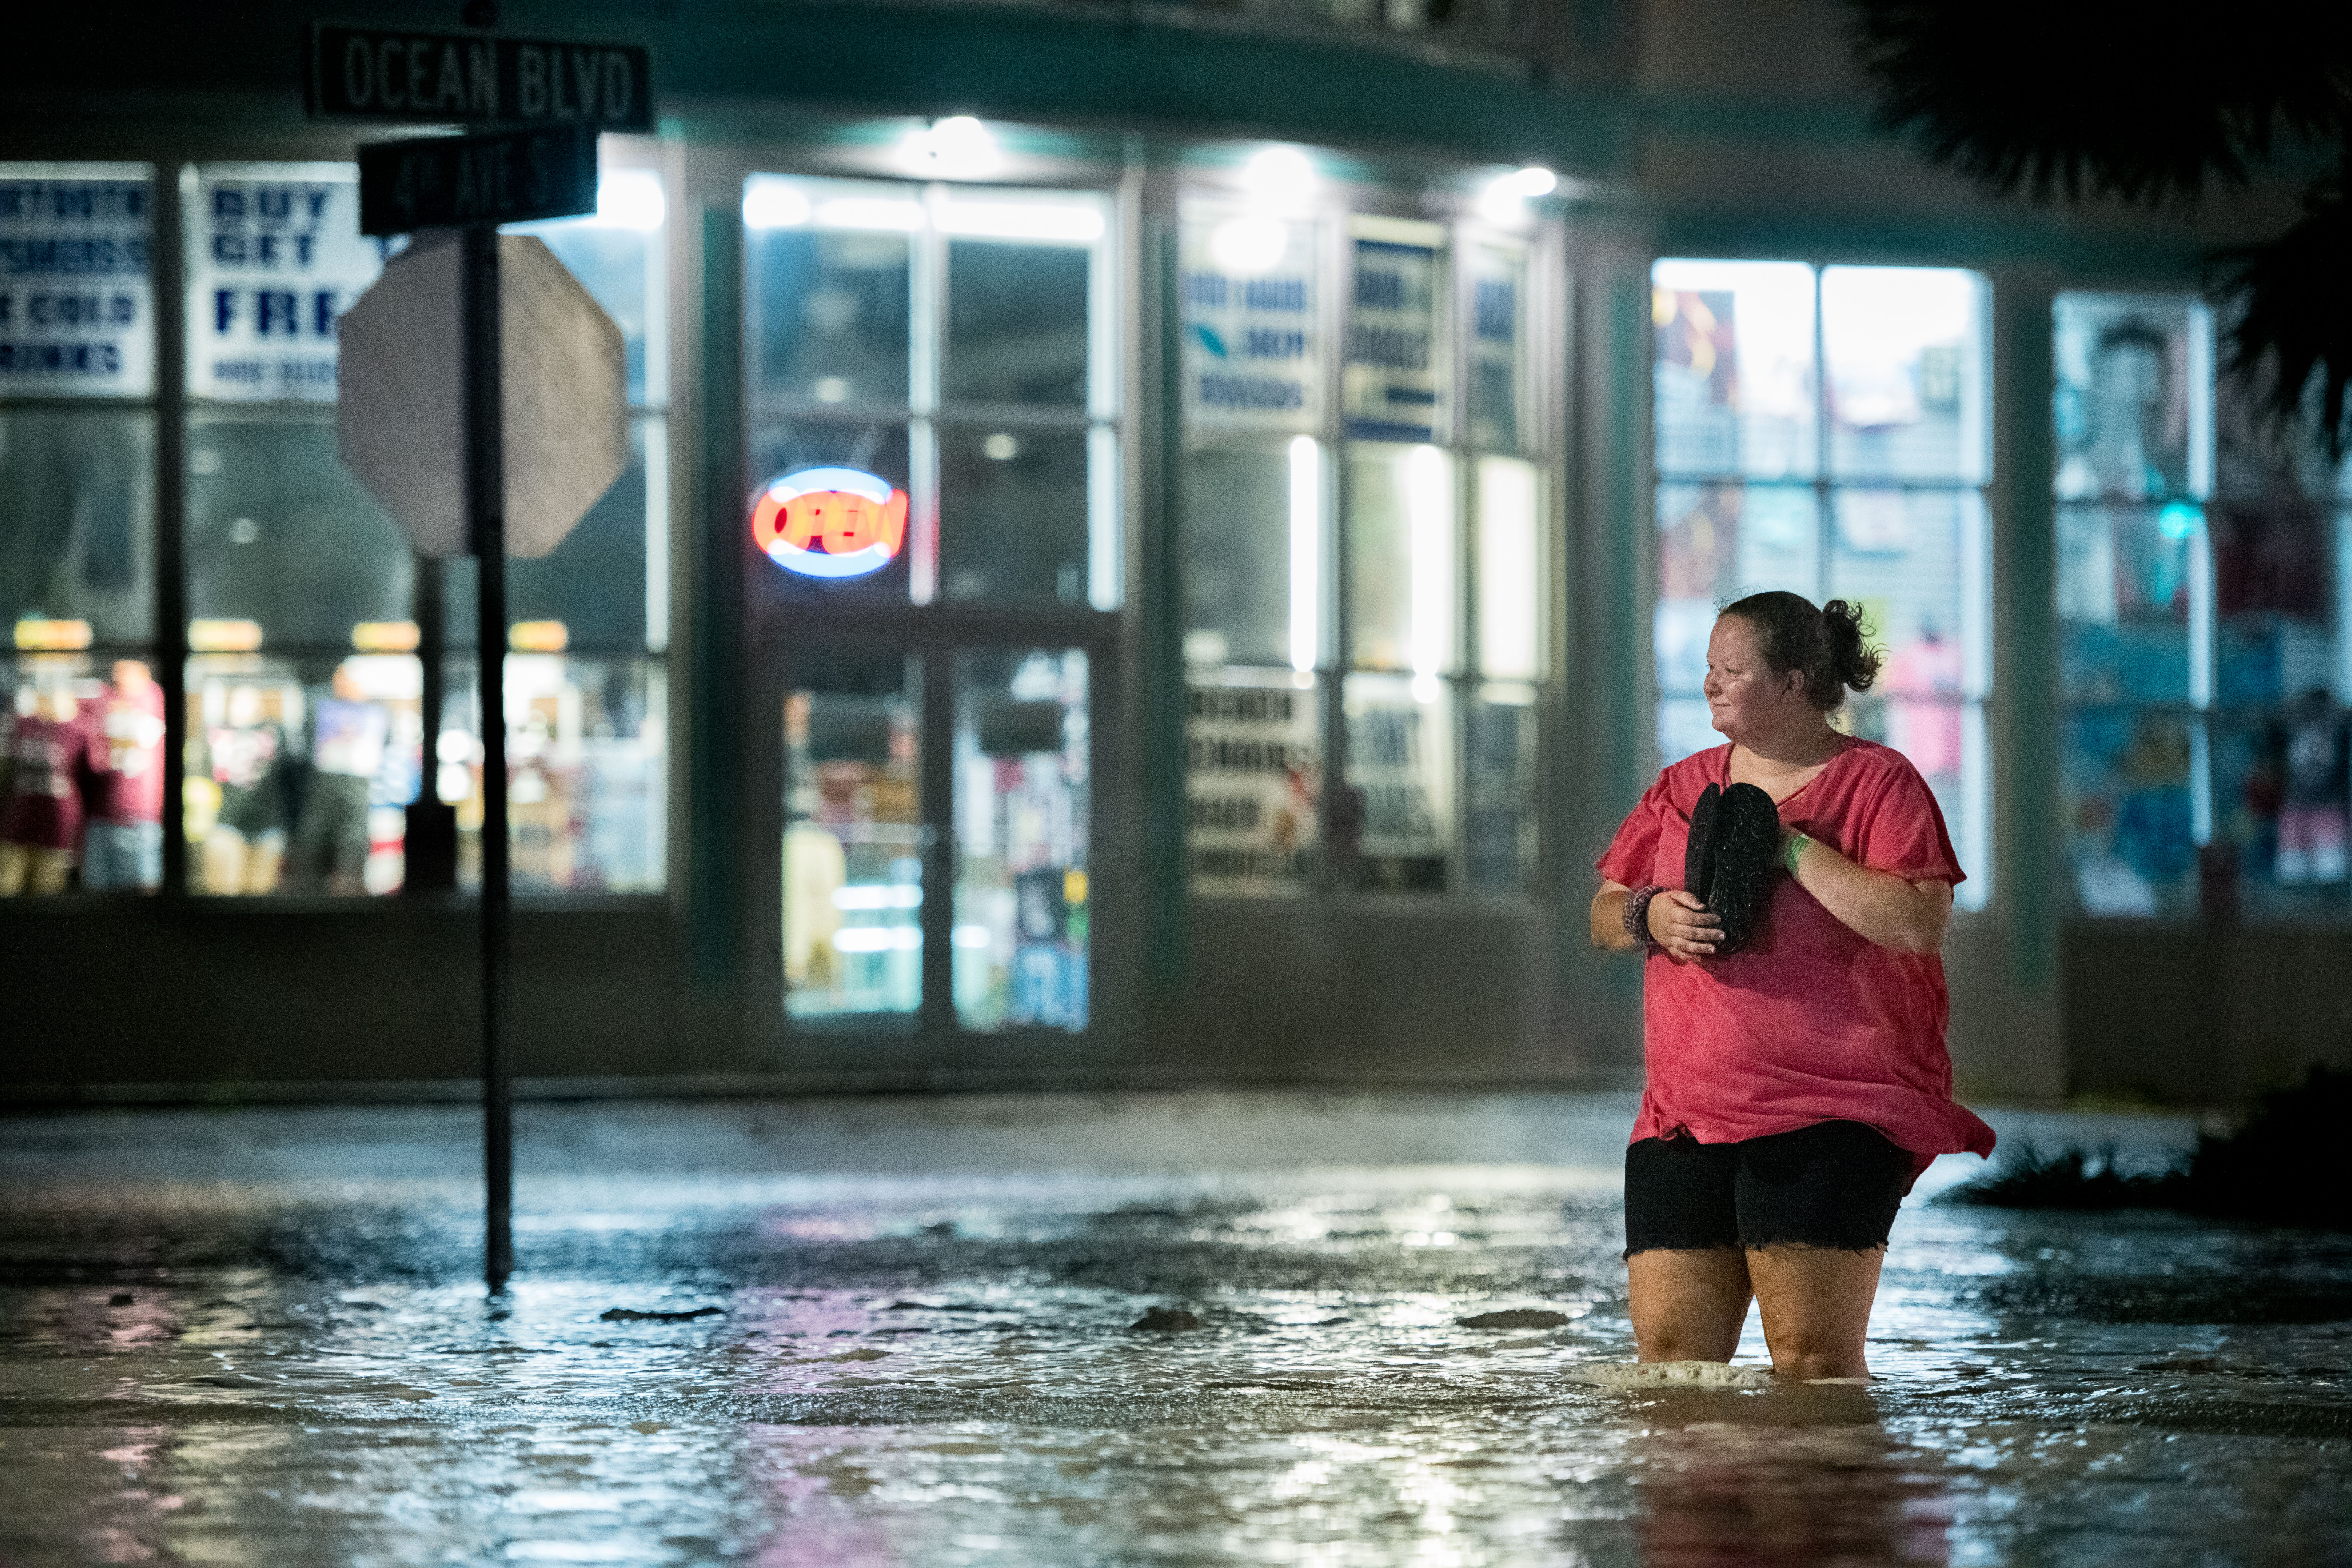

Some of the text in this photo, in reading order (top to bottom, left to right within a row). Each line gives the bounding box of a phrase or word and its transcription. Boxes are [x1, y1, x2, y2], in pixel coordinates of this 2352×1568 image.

[343, 35, 634, 122] OCEAN BLVD
[213, 189, 329, 218] BUY
[213, 233, 315, 264] GET
[215, 289, 338, 336] FRE
[751, 488, 909, 558] OPEN
